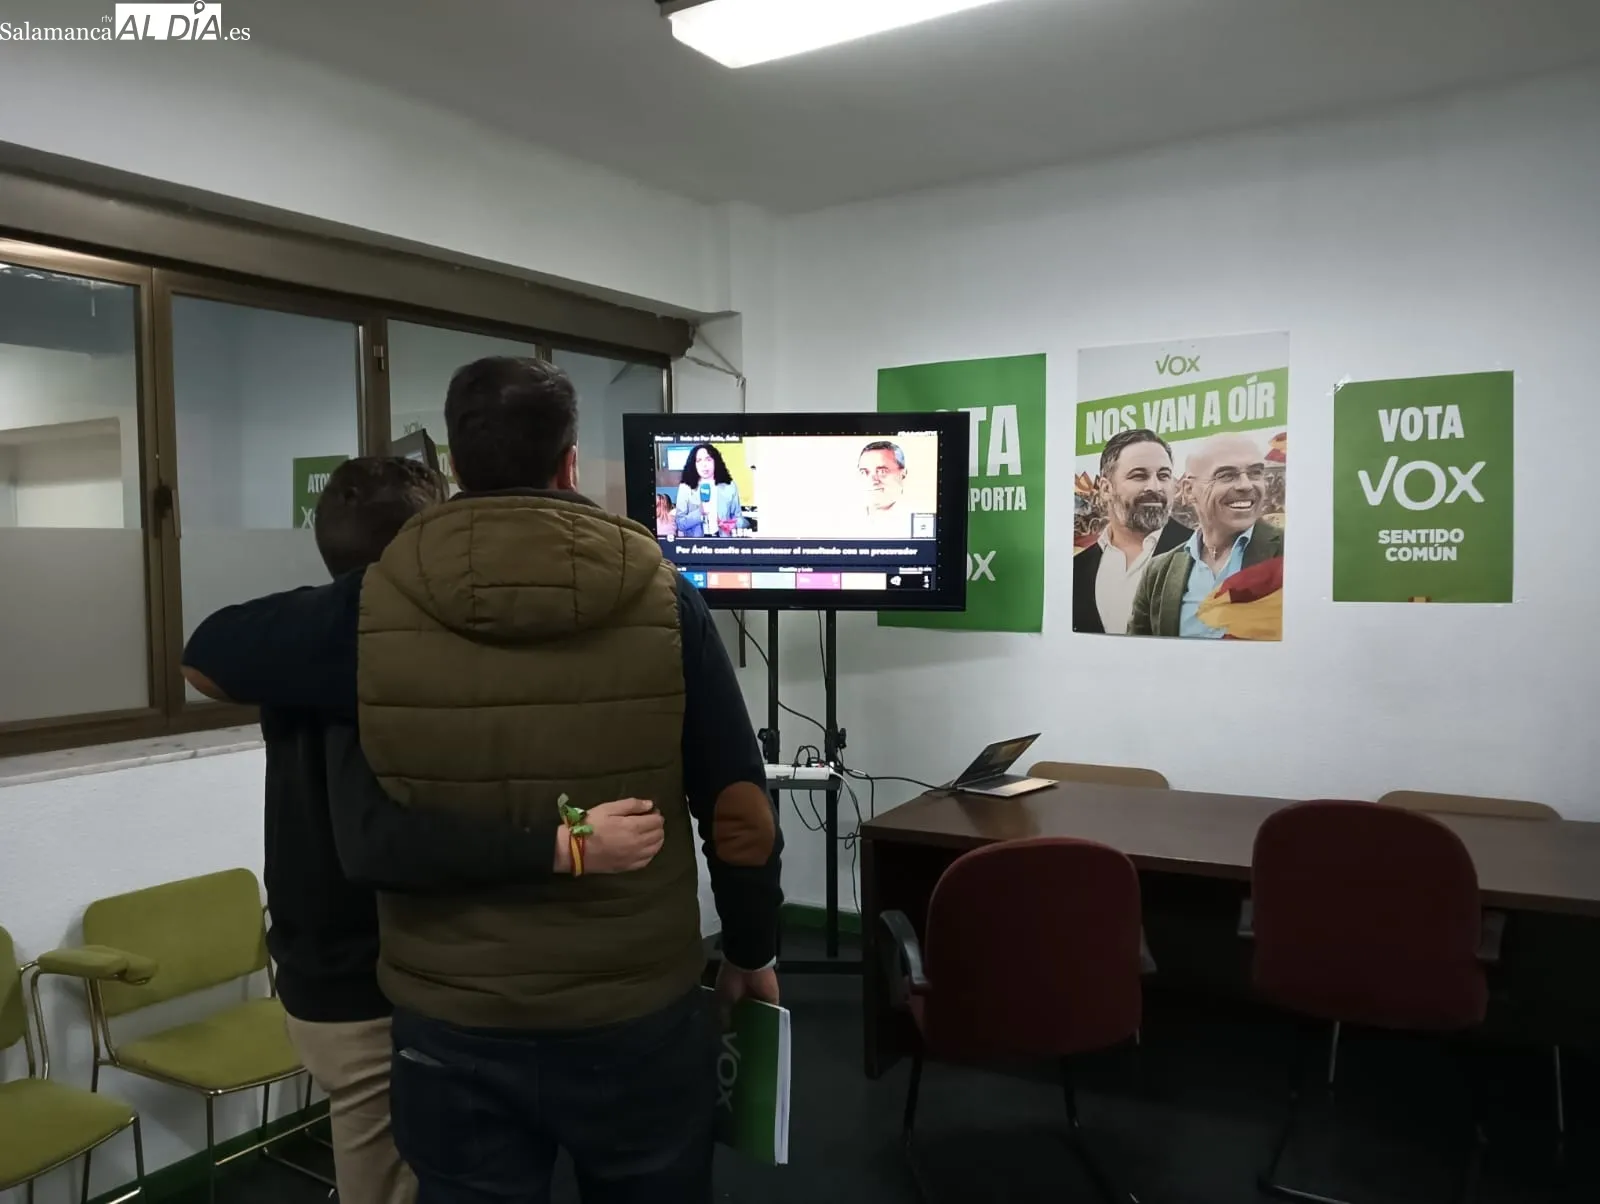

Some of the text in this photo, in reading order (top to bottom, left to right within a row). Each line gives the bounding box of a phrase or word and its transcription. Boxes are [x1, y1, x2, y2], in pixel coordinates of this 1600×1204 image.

[1154, 353, 1201, 376] VOX
[1085, 376, 1275, 446] NOS VAN A OÍR
[1378, 404, 1465, 443] VOTA
[964, 403, 1022, 477] TA
[967, 486, 1027, 511] PORTA
[1357, 455, 1487, 511] VOX
[1378, 528, 1465, 545] SENTIDO
[1385, 543, 1457, 562] COMÚN
[716, 1031, 741, 1113] VOX
